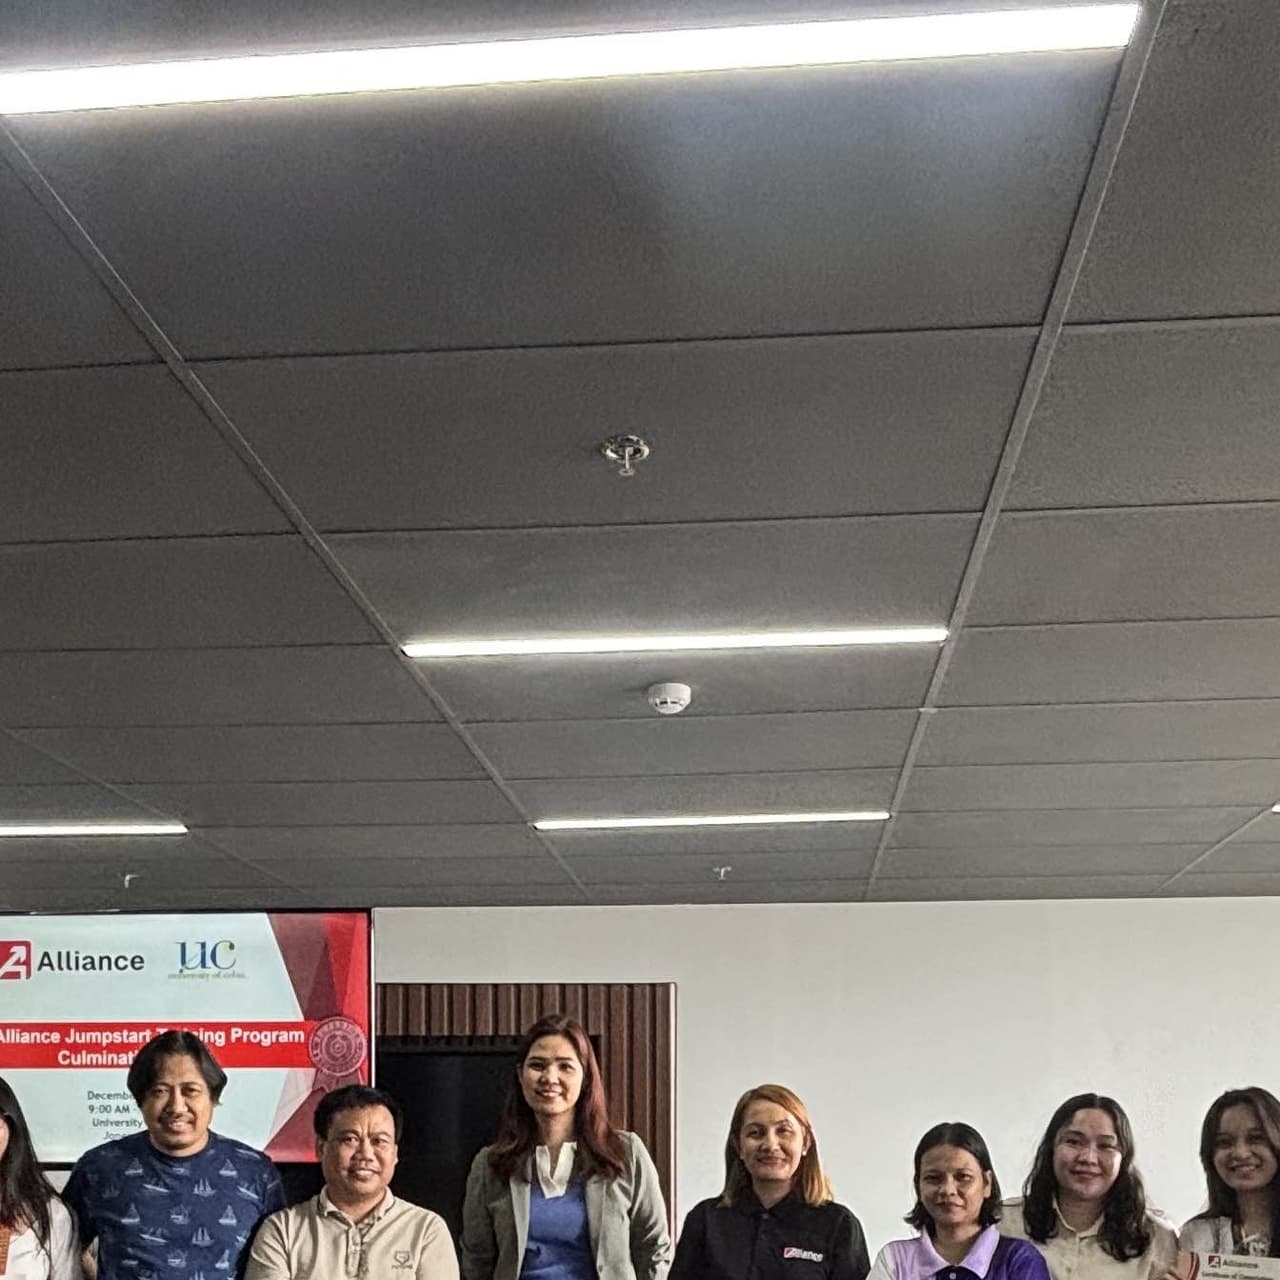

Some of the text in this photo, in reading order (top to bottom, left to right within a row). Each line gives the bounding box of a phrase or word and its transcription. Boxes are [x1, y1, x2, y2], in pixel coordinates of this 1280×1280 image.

[37, 950, 145, 972] Alliance
[65, 1028, 152, 1047] Jumpstart
[231, 1027, 304, 1047] Program
[115, 1105, 130, 1113] AM
[92, 1118, 142, 1128] University
